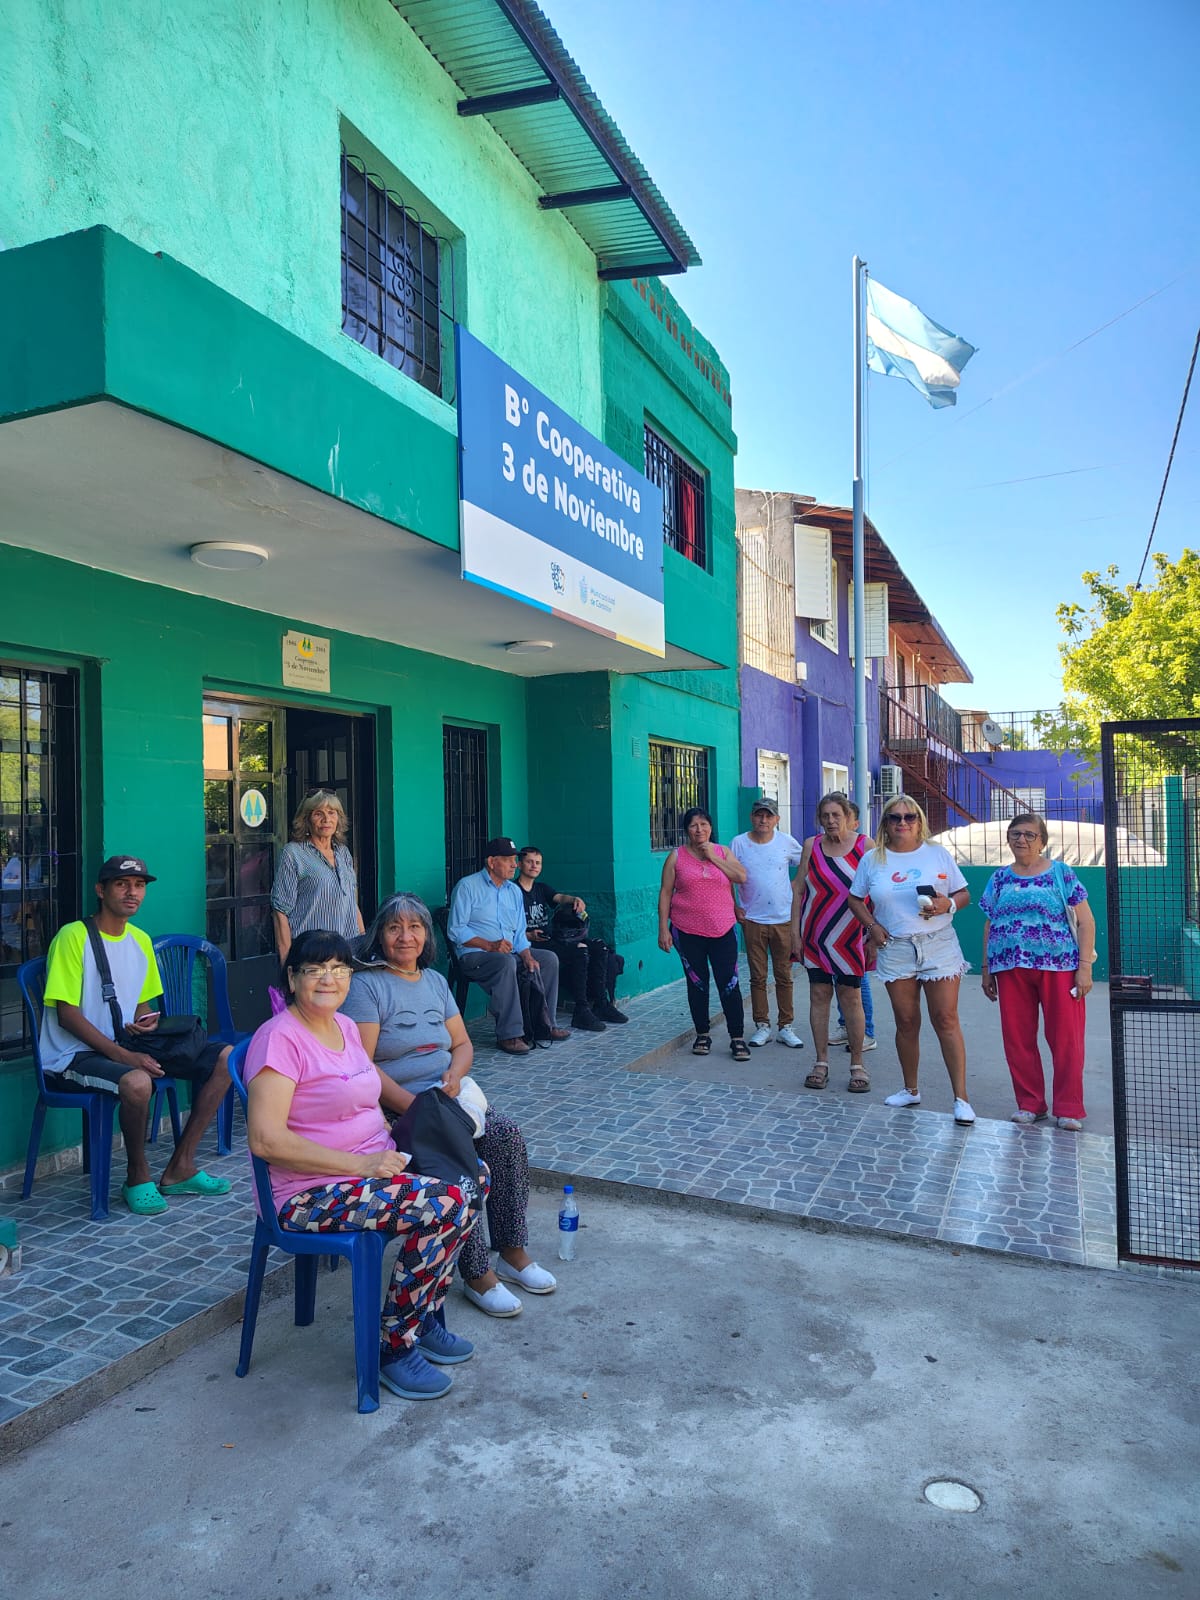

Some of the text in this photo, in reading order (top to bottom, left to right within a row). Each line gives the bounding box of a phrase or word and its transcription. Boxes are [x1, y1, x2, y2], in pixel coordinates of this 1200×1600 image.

[502, 442, 644, 561] 3 de Noviembre
[536, 411, 641, 514] Cooperativa
